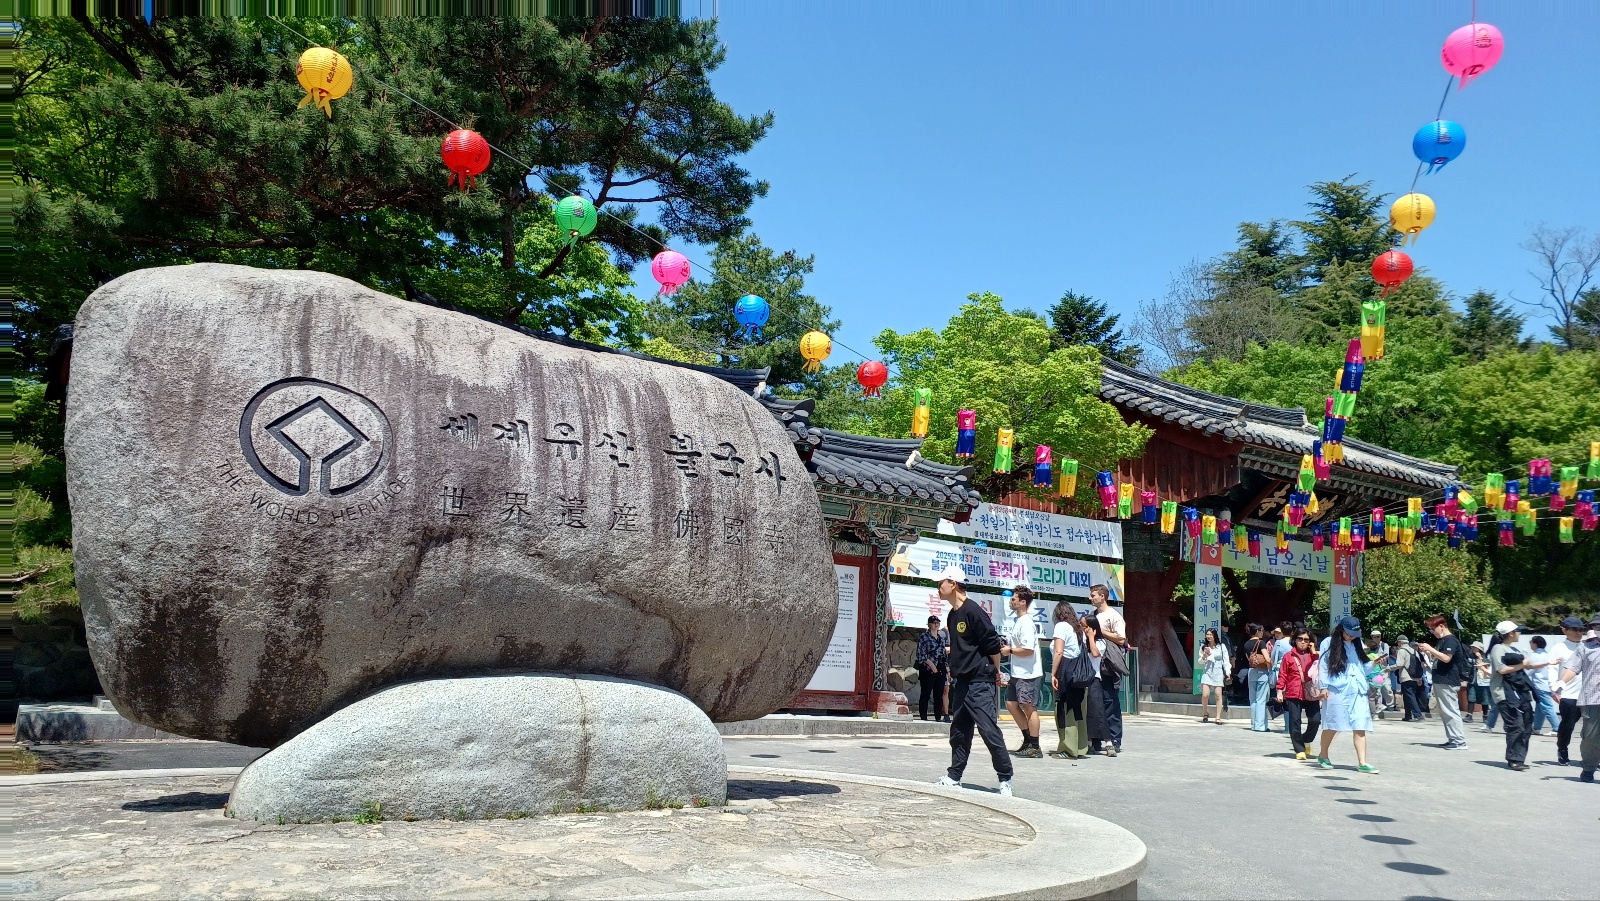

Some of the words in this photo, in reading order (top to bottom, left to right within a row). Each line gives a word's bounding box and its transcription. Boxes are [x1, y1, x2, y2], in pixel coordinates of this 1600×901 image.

[439, 412, 635, 468] 세계유산
[663, 433, 787, 497] 불국사
[215, 458, 247, 492] THE
[249, 491, 320, 525] WORLD
[332, 474, 410, 522] HERITAGE
[673, 509, 785, 553] 佛國寺
[1018, 509, 1051, 522] 부처님오신날
[1066, 526, 1112, 547] 접수합니다
[931, 558, 957, 574] 불국
[959, 563, 984, 577] 어린이
[935, 550, 958, 561] 2025년
[1228, 541, 1330, 574] 부님오신날
[1069, 570, 1091, 588] 대회
[1210, 573, 1221, 613] 세상에
[1198, 576, 1209, 617] 마음에
